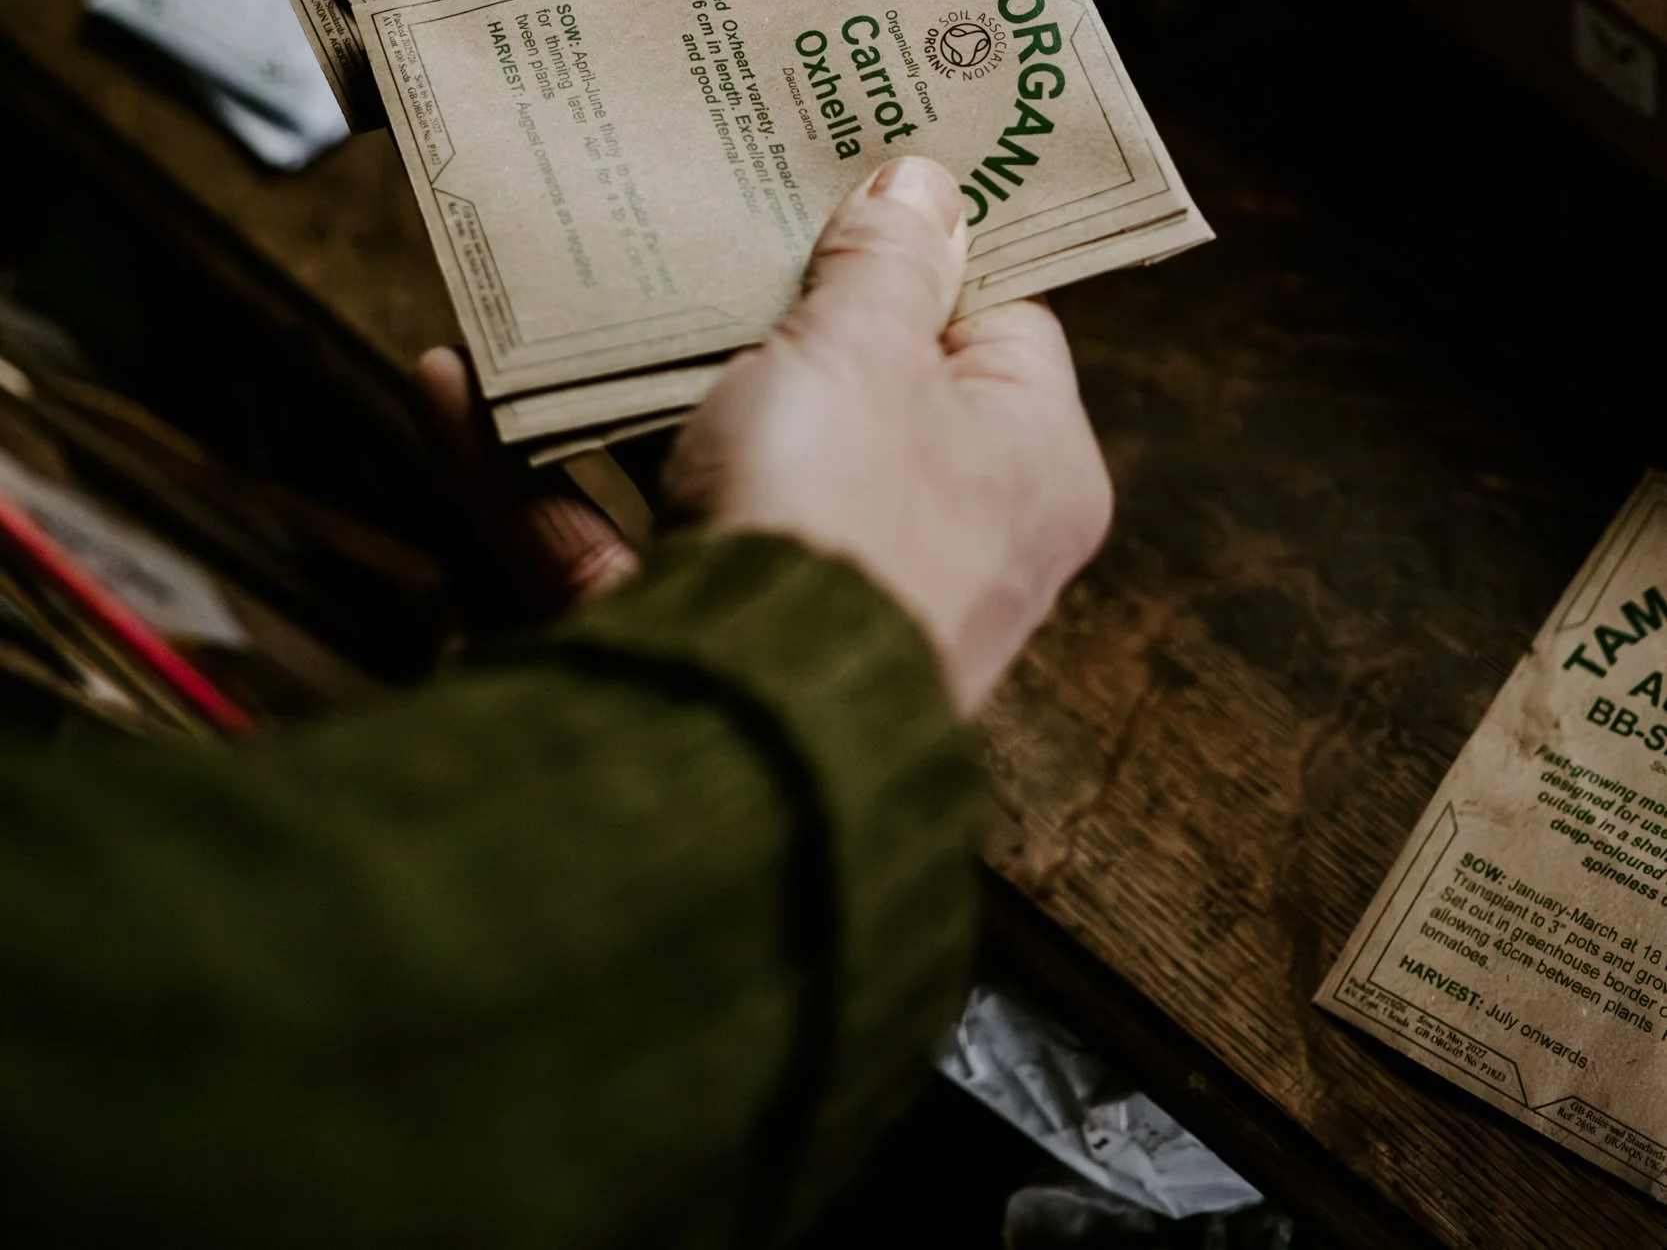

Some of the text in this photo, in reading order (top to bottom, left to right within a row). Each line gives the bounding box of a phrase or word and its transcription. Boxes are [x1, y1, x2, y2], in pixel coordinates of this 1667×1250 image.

[514, 13, 539, 57] tween
[696, 12, 714, 36] cm
[705, 39, 722, 55] in
[924, 27, 956, 80] ORGANIC
[486, 20, 524, 91] HARVEST:
[514, 101, 545, 147] August
[535, 8, 553, 28] for
[544, 34, 573, 90] thinning
[582, 135, 602, 160] Aim
[555, 3, 582, 47] SOW:
[570, 50, 606, 119] April-June
[712, 58, 743, 111] length.
[781, 66, 804, 107] Daucus
[794, 29, 863, 161] Oxhella
[841, 14, 919, 145] Carrot
[885, 9, 938, 123] Organically Grown
[681, 33, 745, 164] and good internal
[721, 19, 756, 81] Oxheart
[745, 82, 775, 139] variety.
[767, 143, 800, 189] Broad
[733, 113, 773, 182] Excellent
[1533, 742, 1639, 804] Fast-growing
[1539, 769, 1616, 812] designed
[1613, 802, 1641, 824] for
[1536, 790, 1596, 825] outside
[1596, 817, 1616, 835] in
[1616, 829, 1630, 842] a
[1549, 818, 1667, 881] deep-coloured
[1459, 852, 1662, 965] SOW: January-March at 18
[1580, 855, 1659, 900] spineless
[1419, 920, 1489, 970] tomatoes.
[1439, 885, 1658, 1010] Set out in greenhouse border
[1453, 867, 1530, 921] Transplant
[1529, 910, 1546, 928] to
[1563, 931, 1601, 956] pots
[1601, 950, 1636, 975] and
[1429, 907, 1491, 948] allowing
[1492, 937, 1534, 969] 40cm
[1534, 958, 1602, 1005] between
[1398, 954, 1484, 1011] HARVEST:
[1484, 1003, 1520, 1031] July
[1464, 1041, 1488, 1059] 2027
